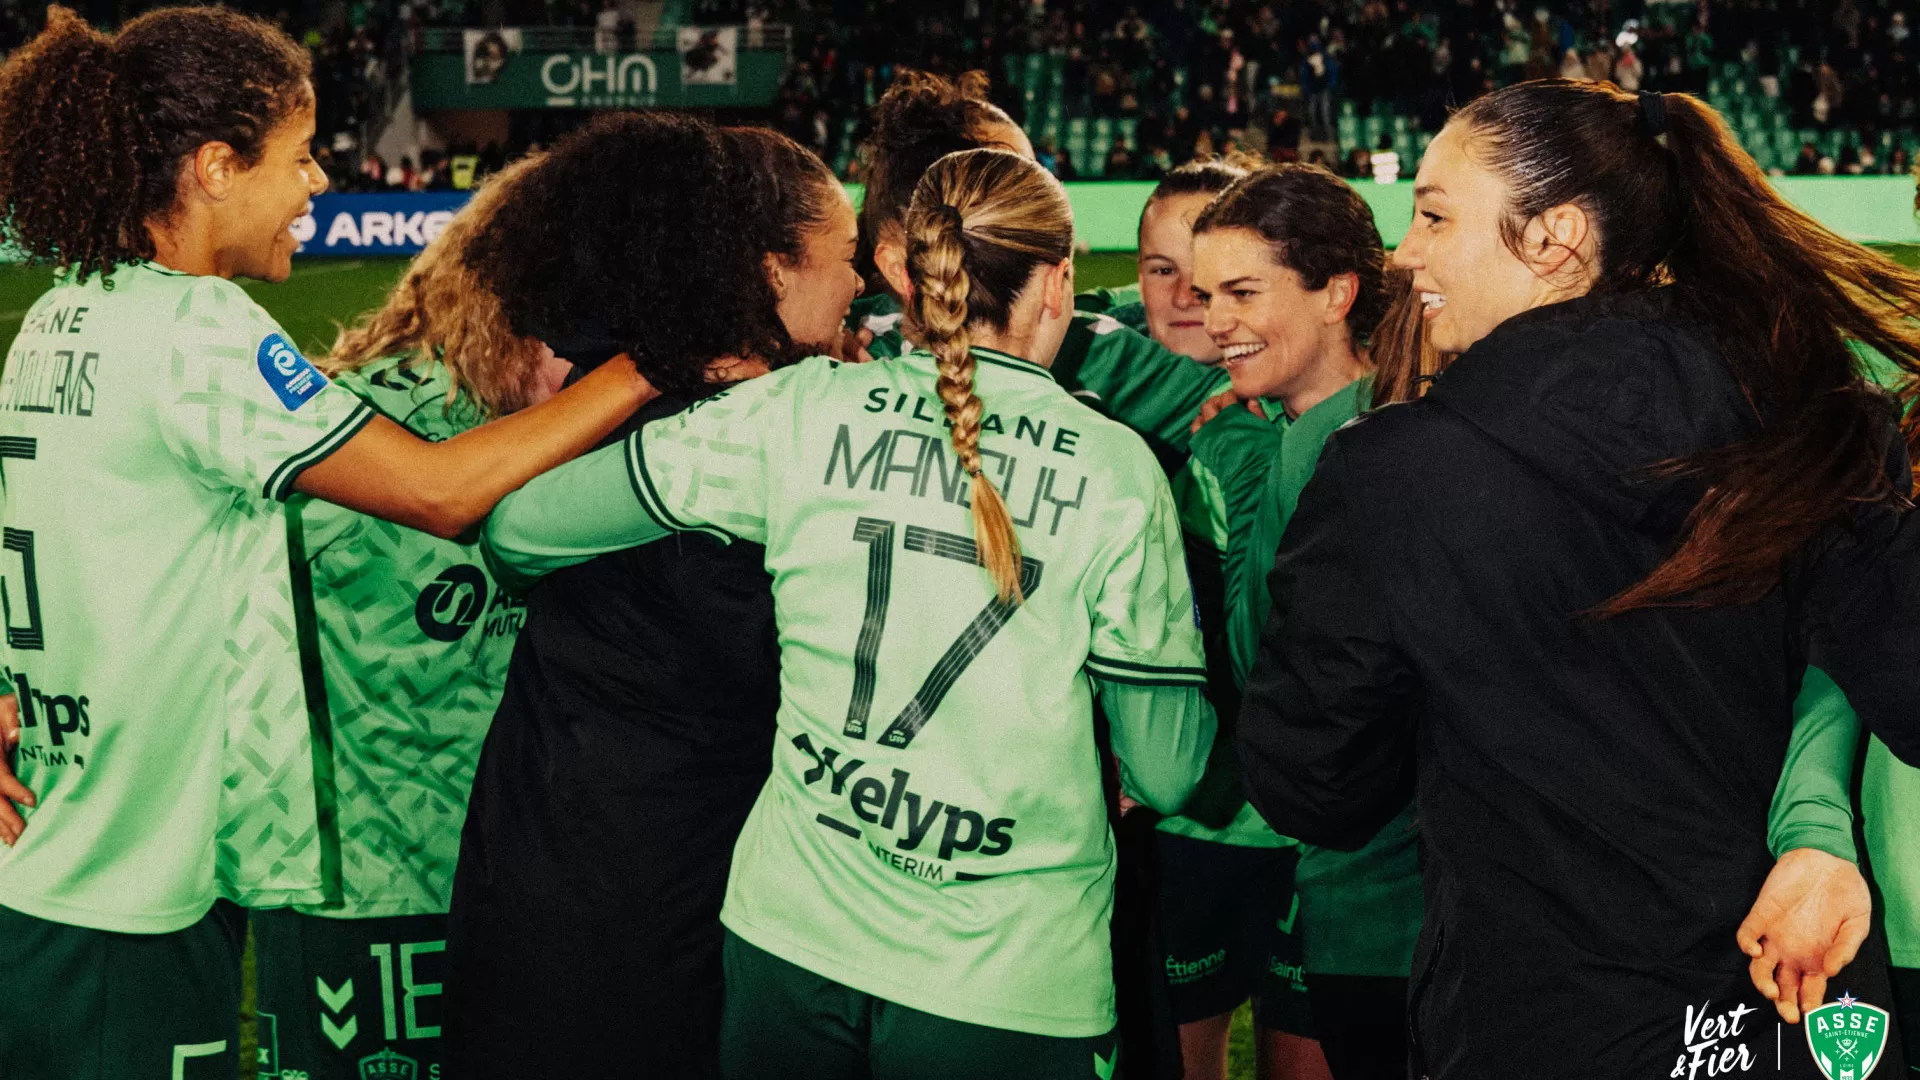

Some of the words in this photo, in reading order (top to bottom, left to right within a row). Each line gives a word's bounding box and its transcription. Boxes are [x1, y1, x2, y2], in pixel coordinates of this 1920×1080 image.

[325, 211, 453, 247] ARKE
[864, 387, 1080, 456] SILANE
[843, 516, 1045, 750] 17
